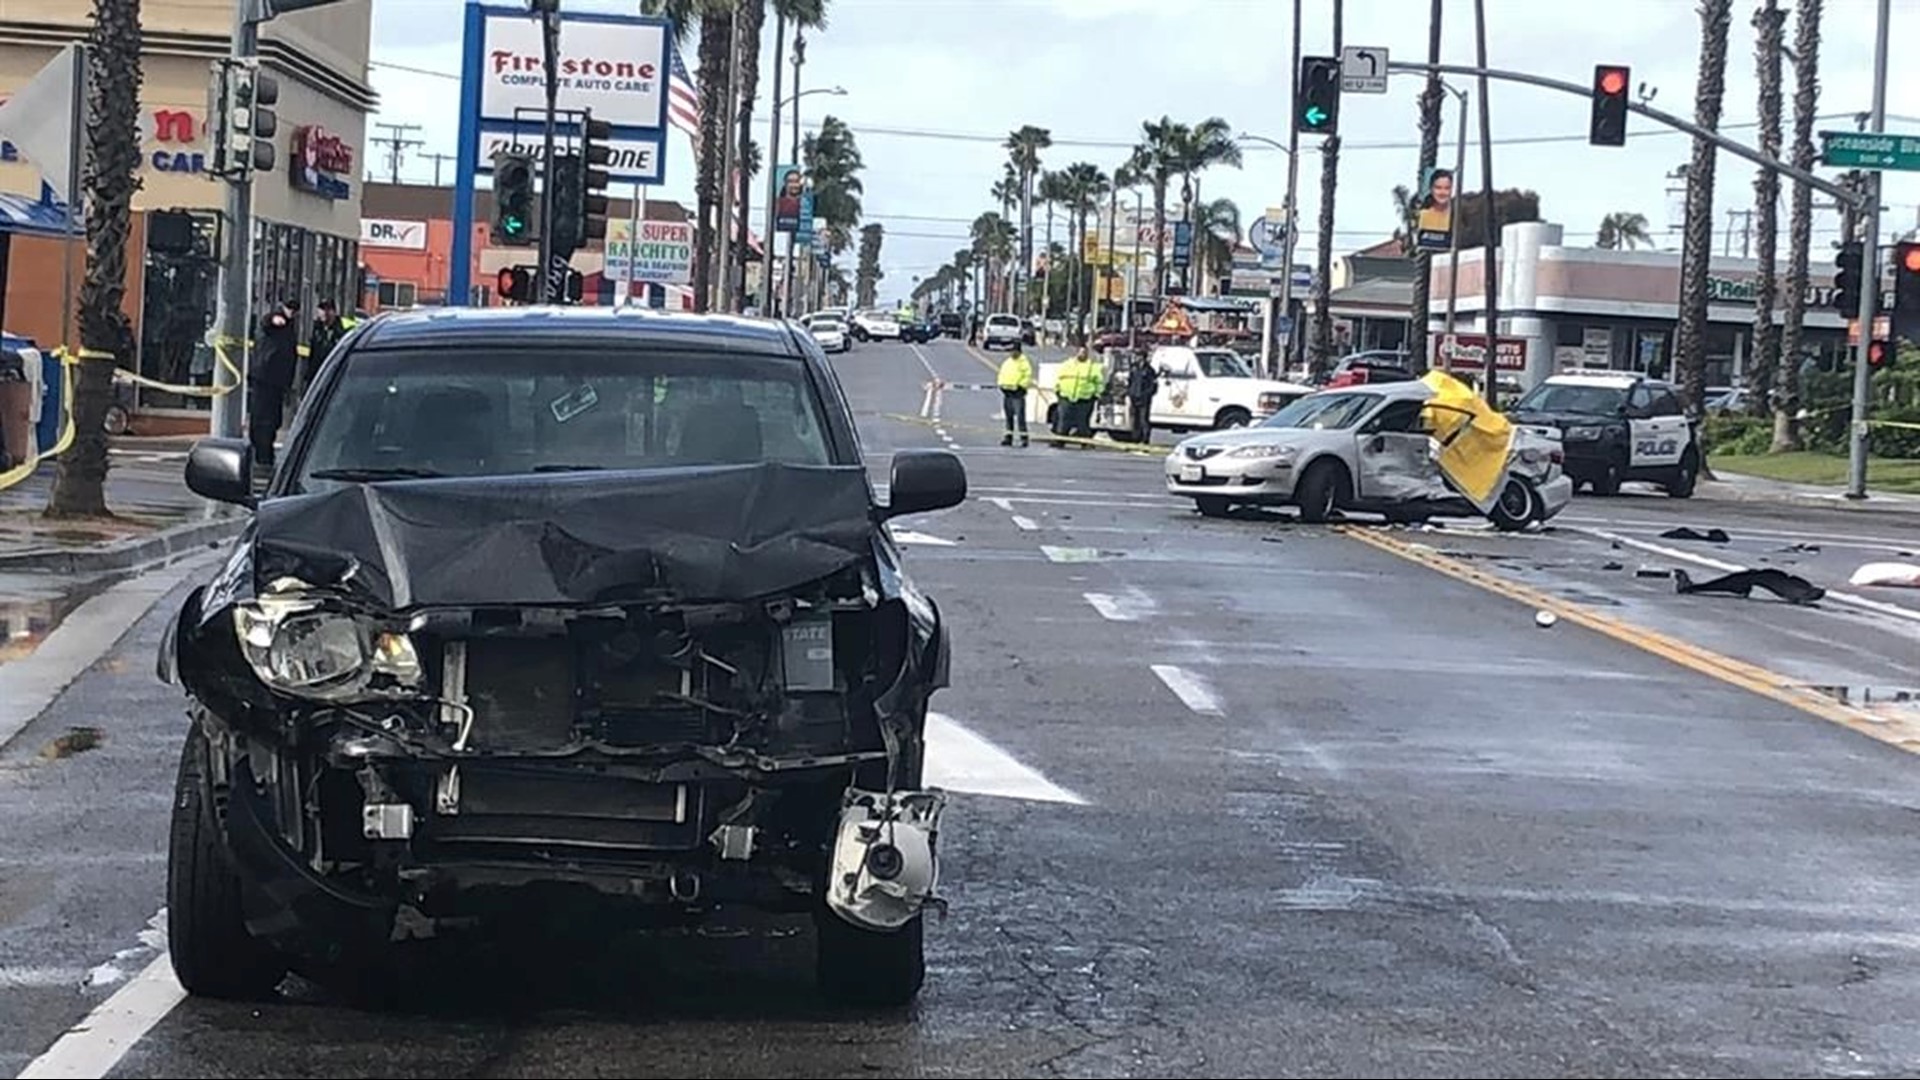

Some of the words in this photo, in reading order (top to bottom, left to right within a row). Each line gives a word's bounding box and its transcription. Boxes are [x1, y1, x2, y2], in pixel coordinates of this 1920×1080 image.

[491, 50, 656, 79] Firstone
[501, 74, 571, 88] COMPLTE
[574, 79, 611, 90] AUTO
[614, 80, 650, 92] CARE
[371, 223, 397, 239] DR.
[642, 224, 688, 242] SUPER
[1634, 441, 1679, 456] POLICE
